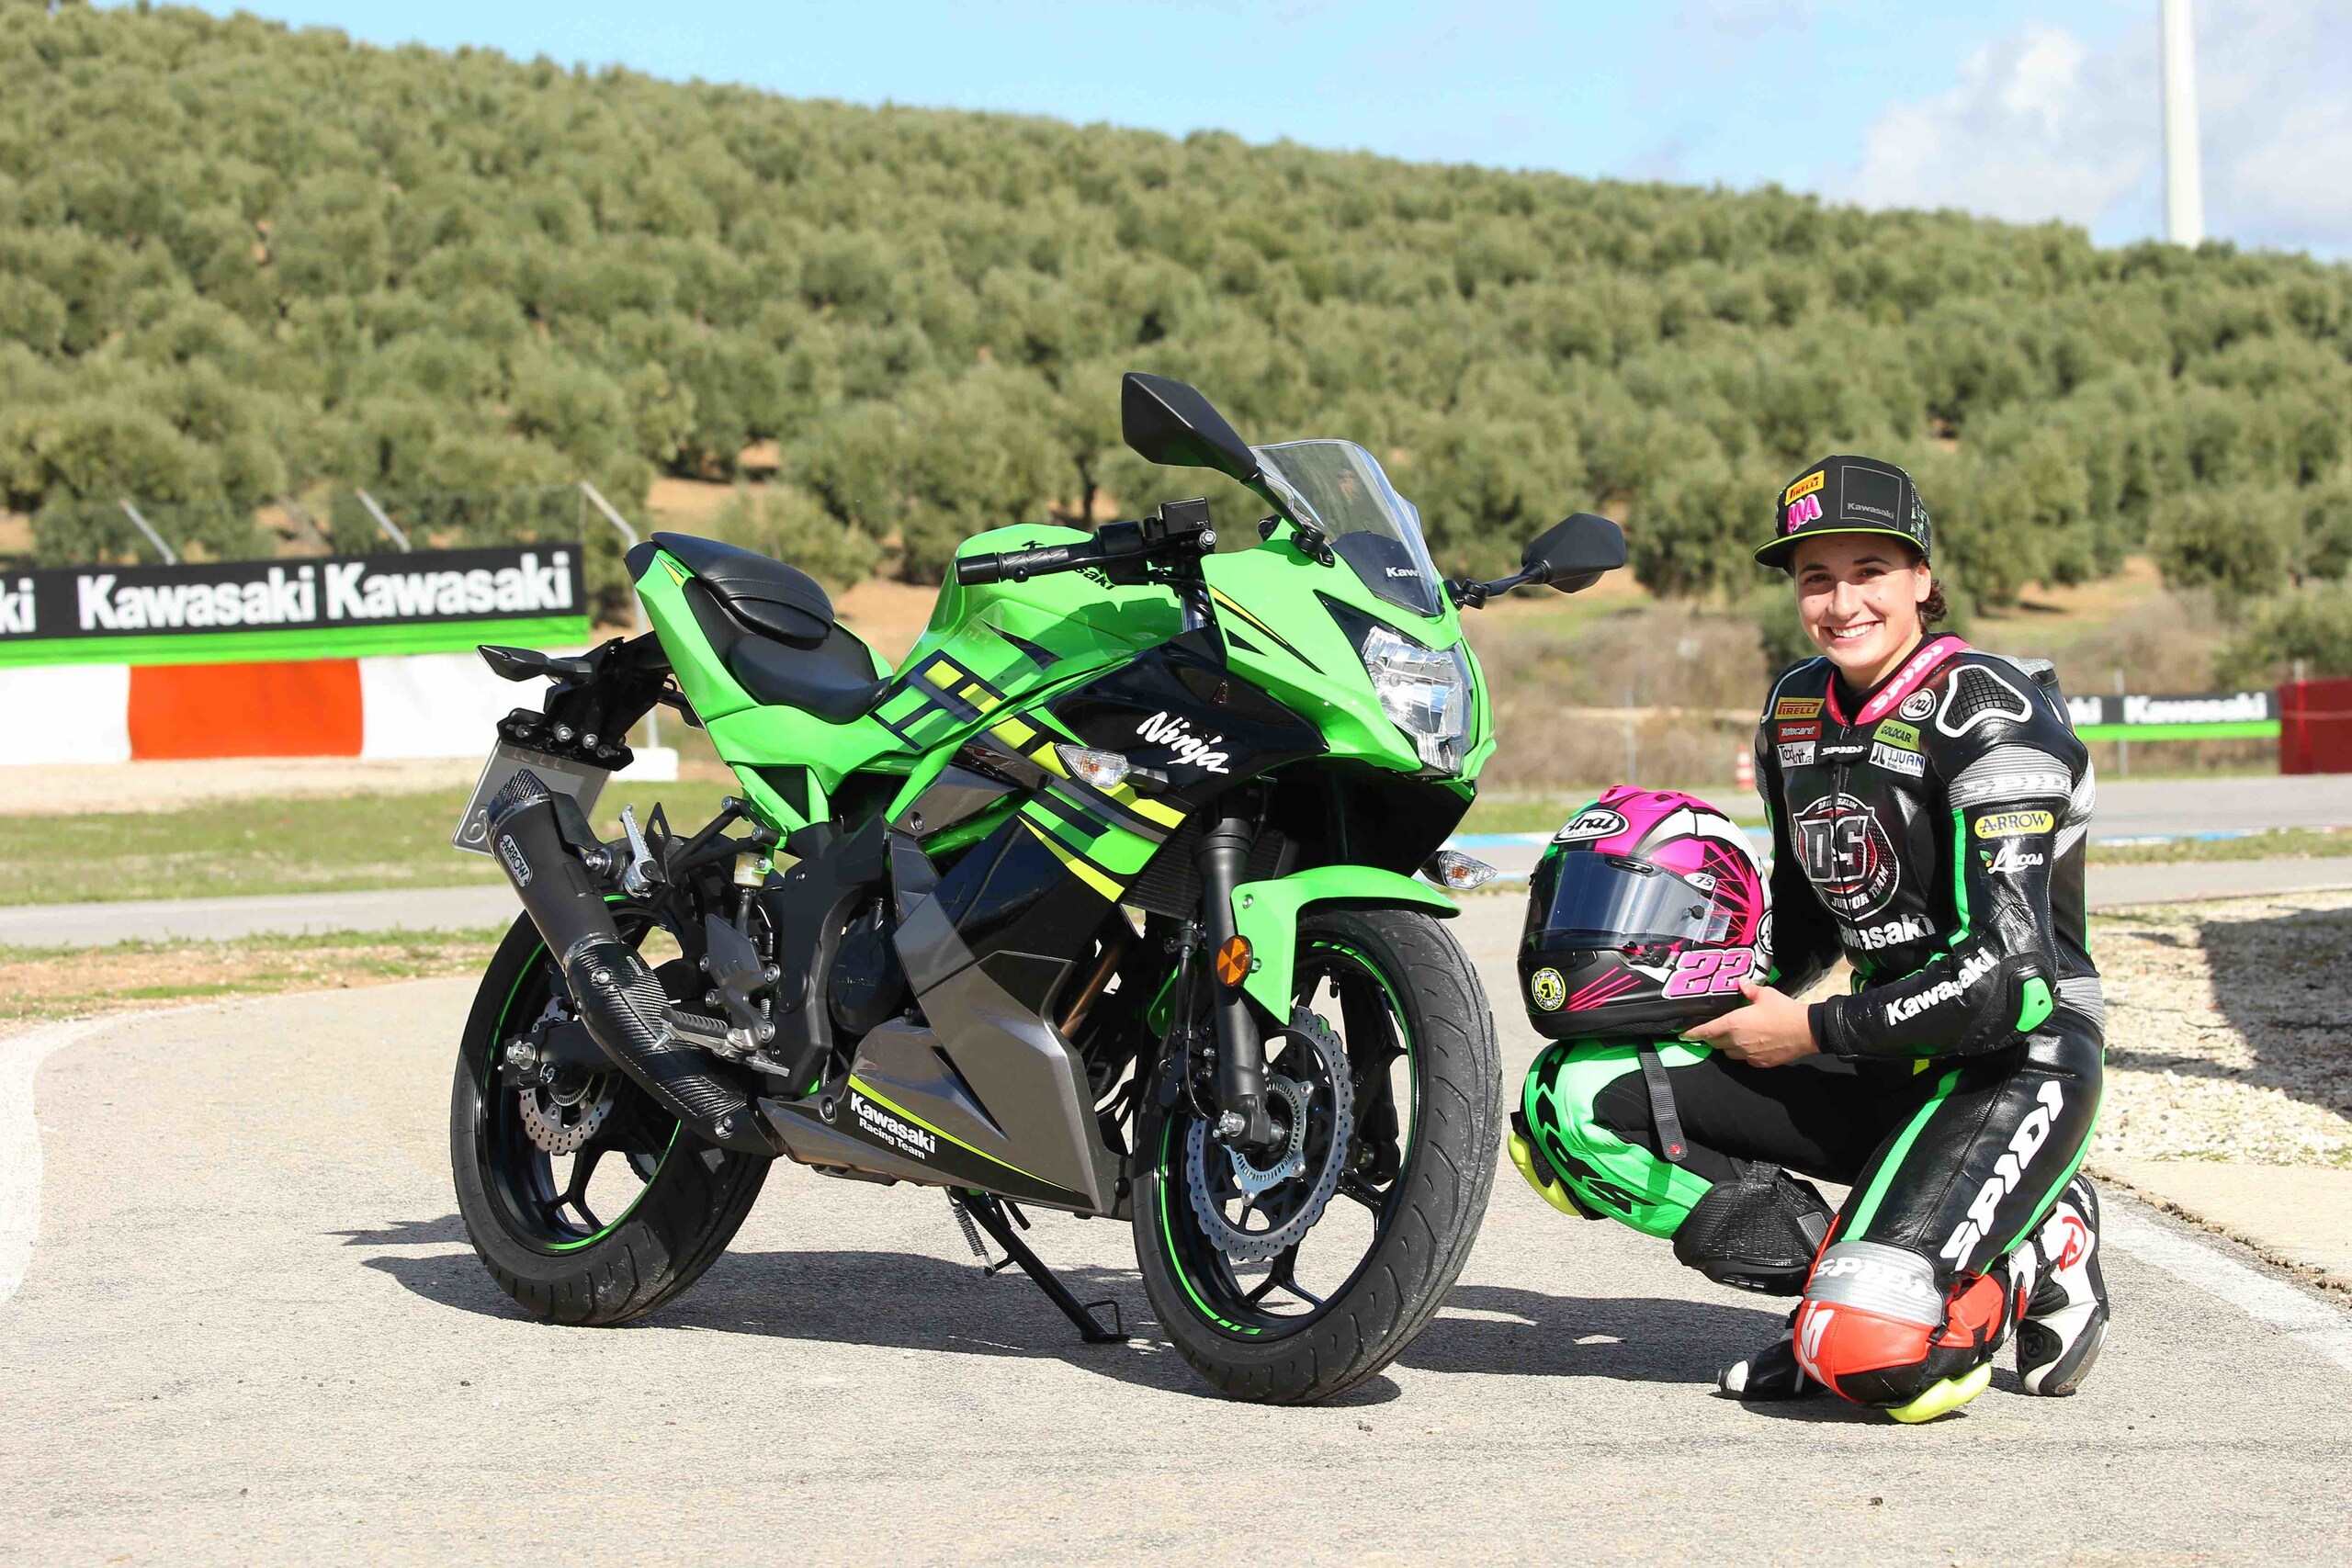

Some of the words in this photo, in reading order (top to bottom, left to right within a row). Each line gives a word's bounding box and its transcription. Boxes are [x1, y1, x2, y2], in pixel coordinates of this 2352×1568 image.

[1789, 476, 1820, 500] PIRELLI
[1847, 502, 1894, 520] Kawasaki
[77, 565, 316, 630] Kawasaki
[324, 551, 573, 620] Kawasaki
[1777, 702, 1820, 716] PIRELLI
[2123, 692, 2268, 724] Kawasaki
[1136, 711, 1231, 773] Ninja
[1568, 814, 1618, 831] Arai
[1979, 813, 2049, 833] ARROW
[502, 839, 529, 878] ARROW
[1869, 863, 1889, 898] TEAM
[1664, 948, 1756, 998] 22
[850, 1091, 936, 1154] Kawasaki
[858, 1118, 895, 1146] Racing
[895, 1136, 926, 1160] Team
[1939, 1079, 2064, 1272] SPIDI
